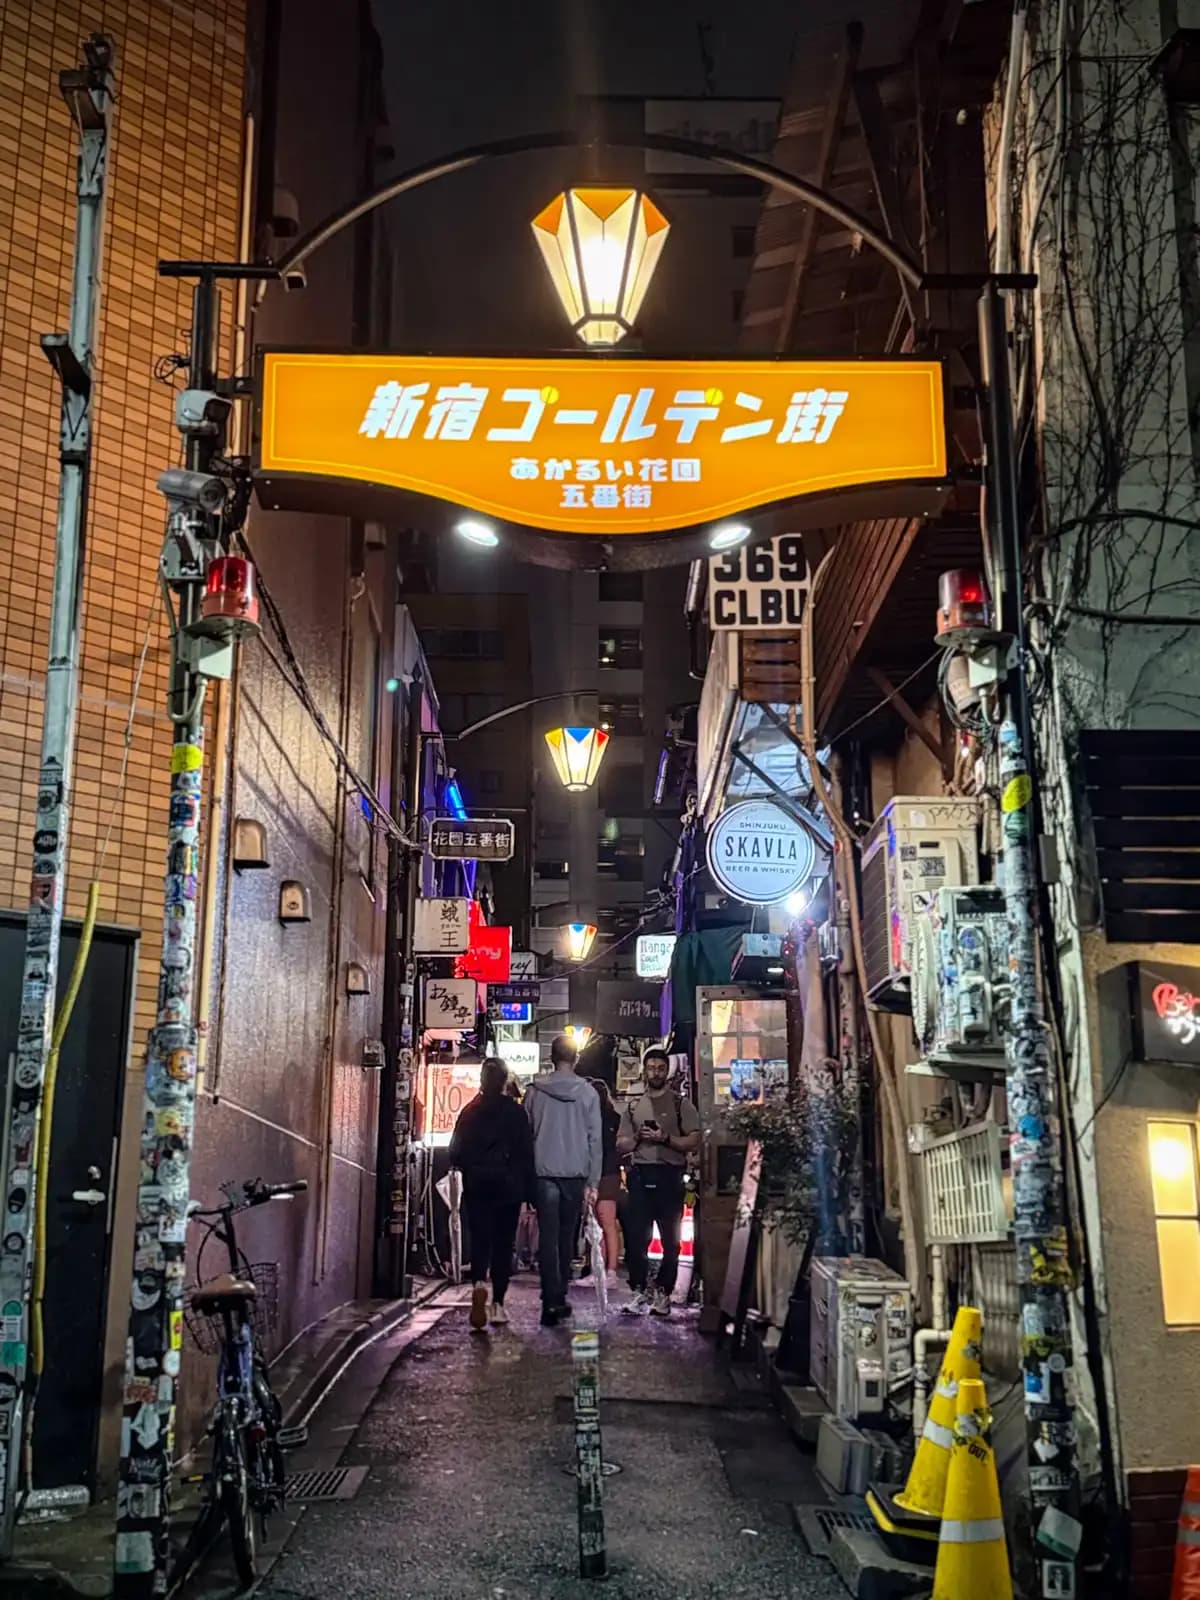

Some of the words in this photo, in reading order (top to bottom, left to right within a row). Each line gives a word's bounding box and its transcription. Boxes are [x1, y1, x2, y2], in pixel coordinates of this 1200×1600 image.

[358, 380, 849, 444] 新宿ゴールデン街
[509, 457, 701, 482] あかるい花園
[559, 483, 652, 508] 五番街
[714, 536, 807, 582] 369
[739, 821, 787, 831] SHINJUKU
[725, 835, 797, 861] SKAVLA
[725, 865, 750, 873] BEER
[760, 866, 797, 876] WHISKY
[432, 1086, 463, 1113] NO
